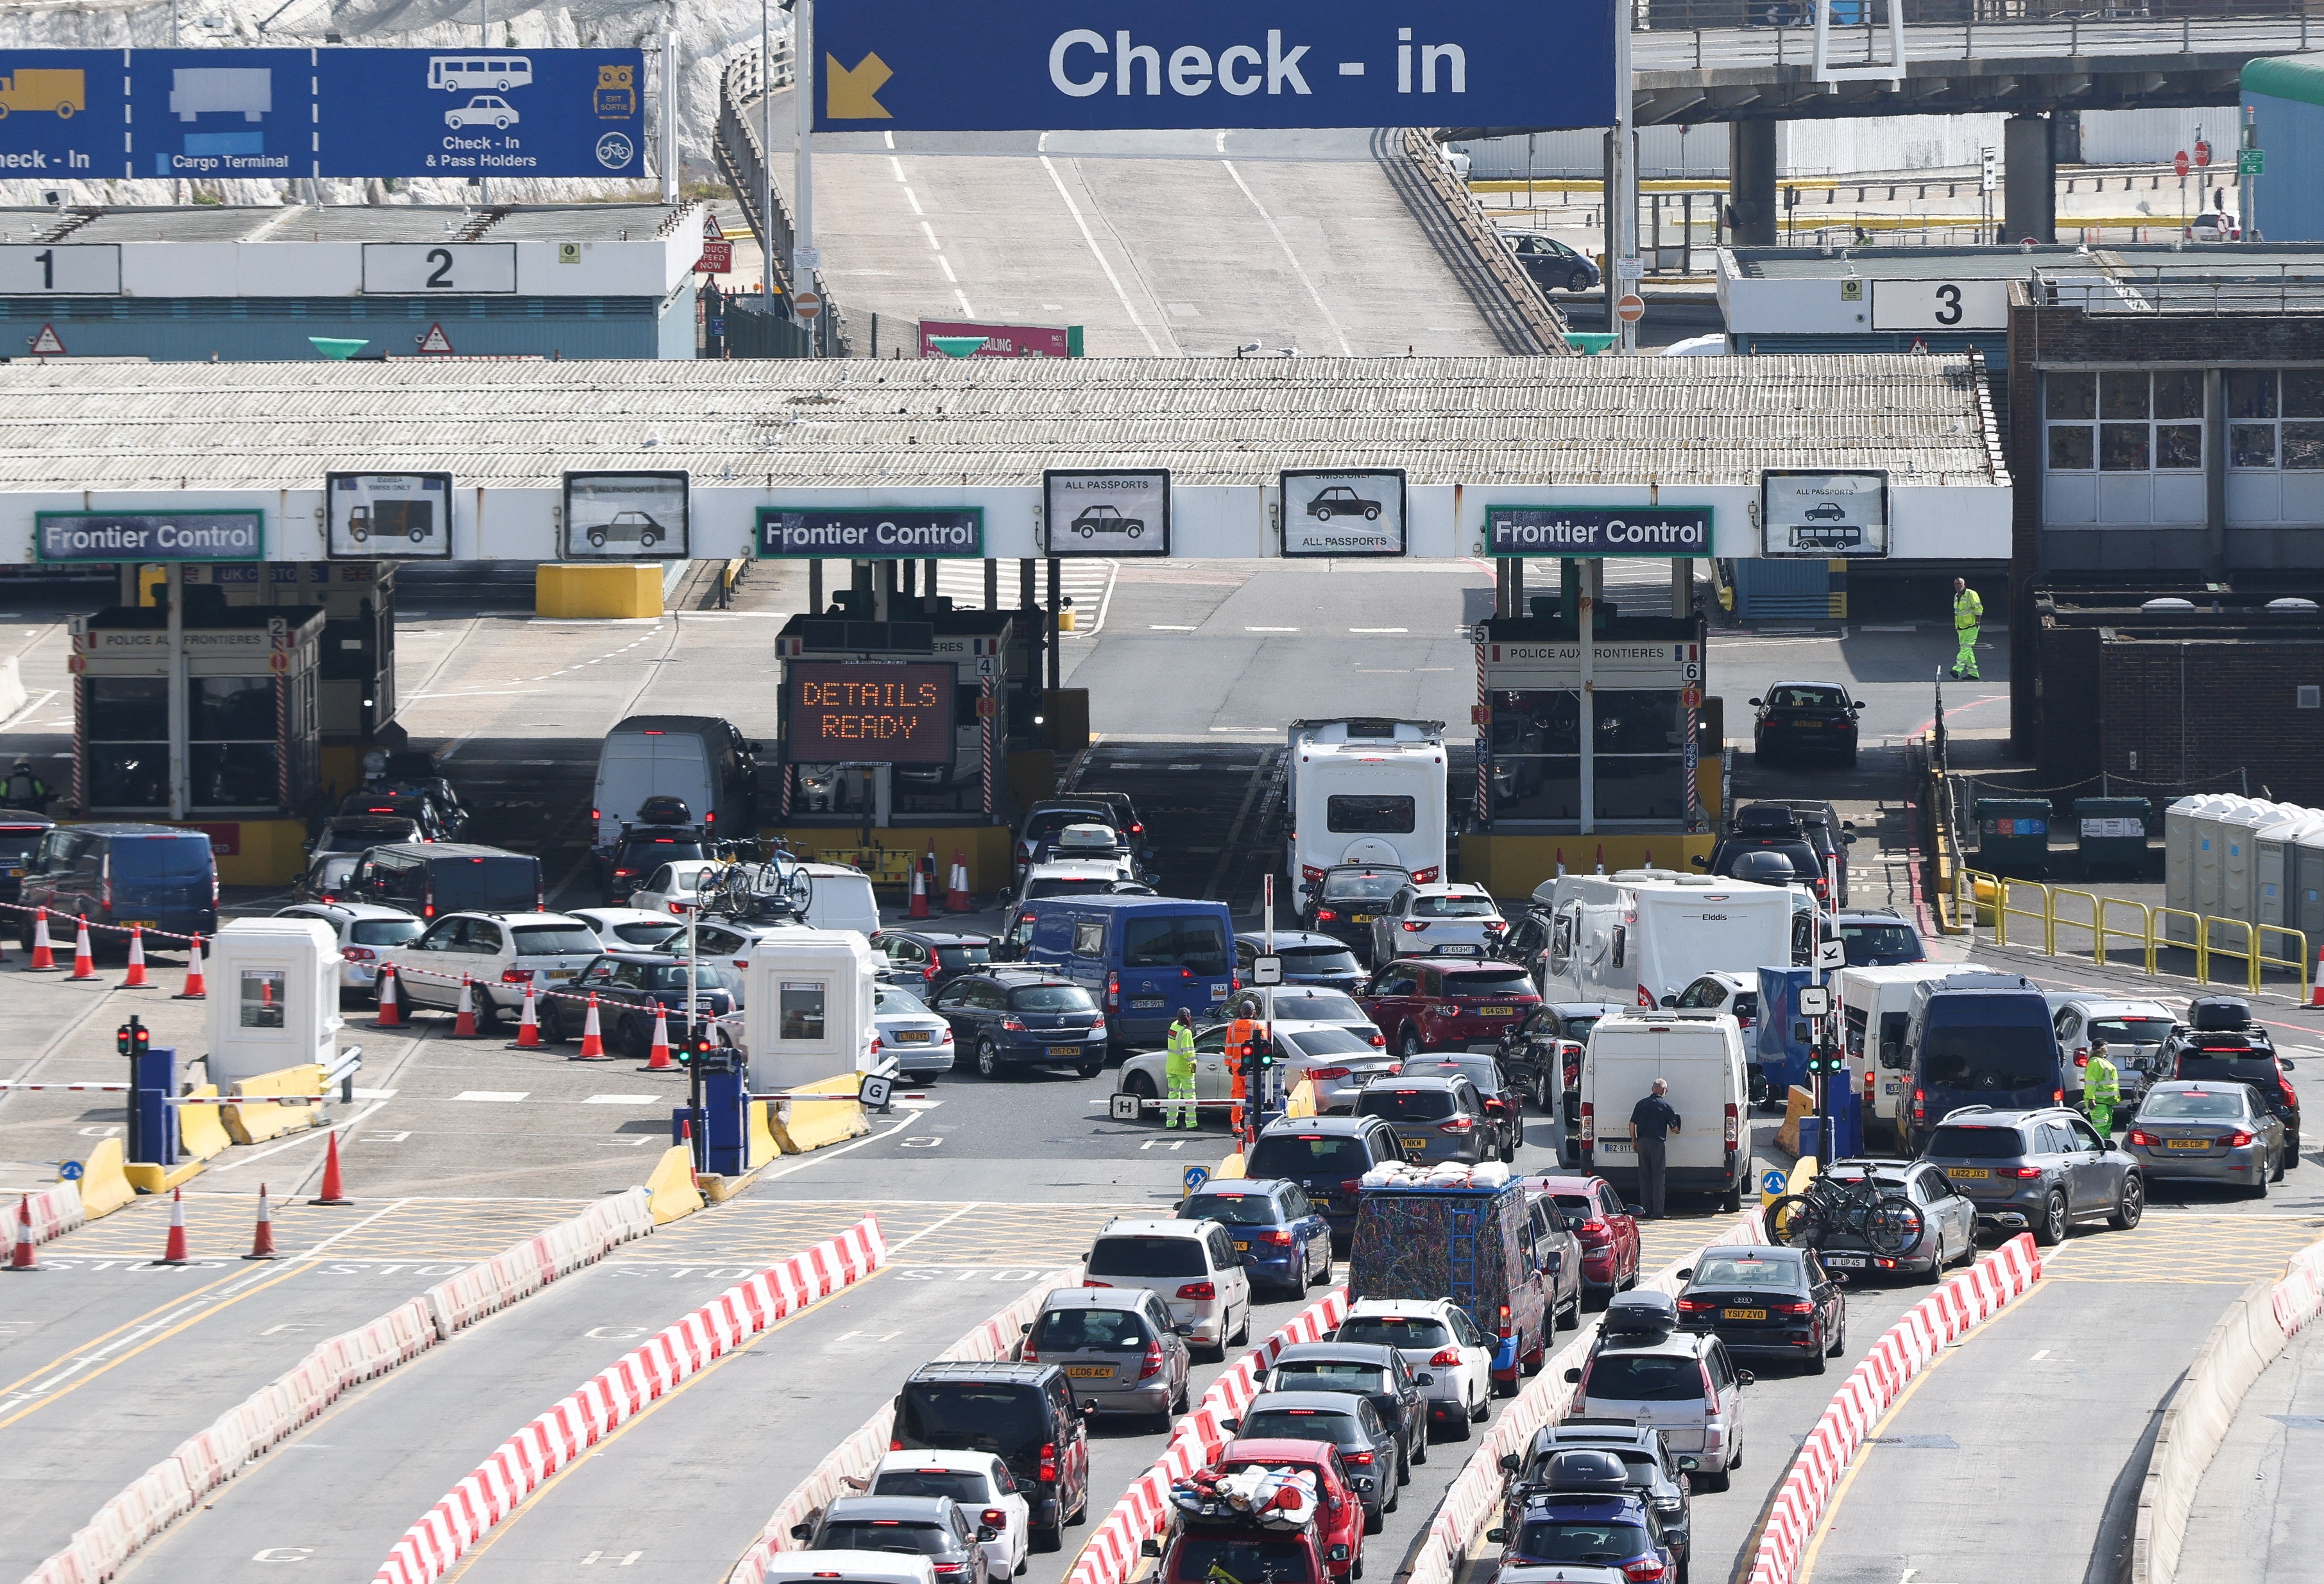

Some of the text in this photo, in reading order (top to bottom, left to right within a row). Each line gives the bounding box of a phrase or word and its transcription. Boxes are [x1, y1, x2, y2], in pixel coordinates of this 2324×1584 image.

[1048, 28, 1312, 98] Check
[1398, 26, 1467, 94] in
[443, 136, 491, 149] Check
[505, 136, 520, 149] In
[0, 149, 47, 168] eck
[69, 149, 90, 168] In
[172, 154, 289, 171] Cargo Terminal
[425, 154, 537, 167] & Pass Holders
[703, 245, 730, 254] DUCE
[35, 249, 54, 289] 1
[425, 248, 454, 288] 2
[1935, 284, 1963, 325] 3
[1087, 481, 1149, 489] PASSPORTS
[44, 524, 255, 549] Frontier Control
[766, 521, 973, 545] Frontier Control
[1496, 519, 1703, 543] Frontier Control
[1303, 537, 1387, 546] ALL PASSPORTS
[222, 568, 318, 581] UK CSTOS
[73, 620, 81, 633] 1
[271, 621, 282, 635] 2
[107, 634, 261, 645] POLICE AU FRONTIERES
[1474, 629, 1485, 642] 5
[1510, 648, 1664, 658] POLICE AUX RONTIERES
[980, 660, 991, 673] 4
[1686, 663, 1697, 678] 6
[803, 682, 937, 707] DETAILS
[822, 714, 918, 739] READY
[1823, 947, 1838, 961] K
[1807, 996, 1820, 1005] J
[869, 1083, 883, 1097] G
[1120, 1101, 1132, 1112] H
[1951, 1168, 1986, 1179] LN22 JXS
[1851, 1258, 1860, 1266] 45
[318, 1264, 466, 1275] STO
[611, 1267, 755, 1278] STO
[1727, 1309, 1764, 1319] YS17 ZVO
[1070, 1368, 1111, 1377] LC06 ACY
[252, 1547, 314, 1562] G
[580, 1550, 644, 1566] H
